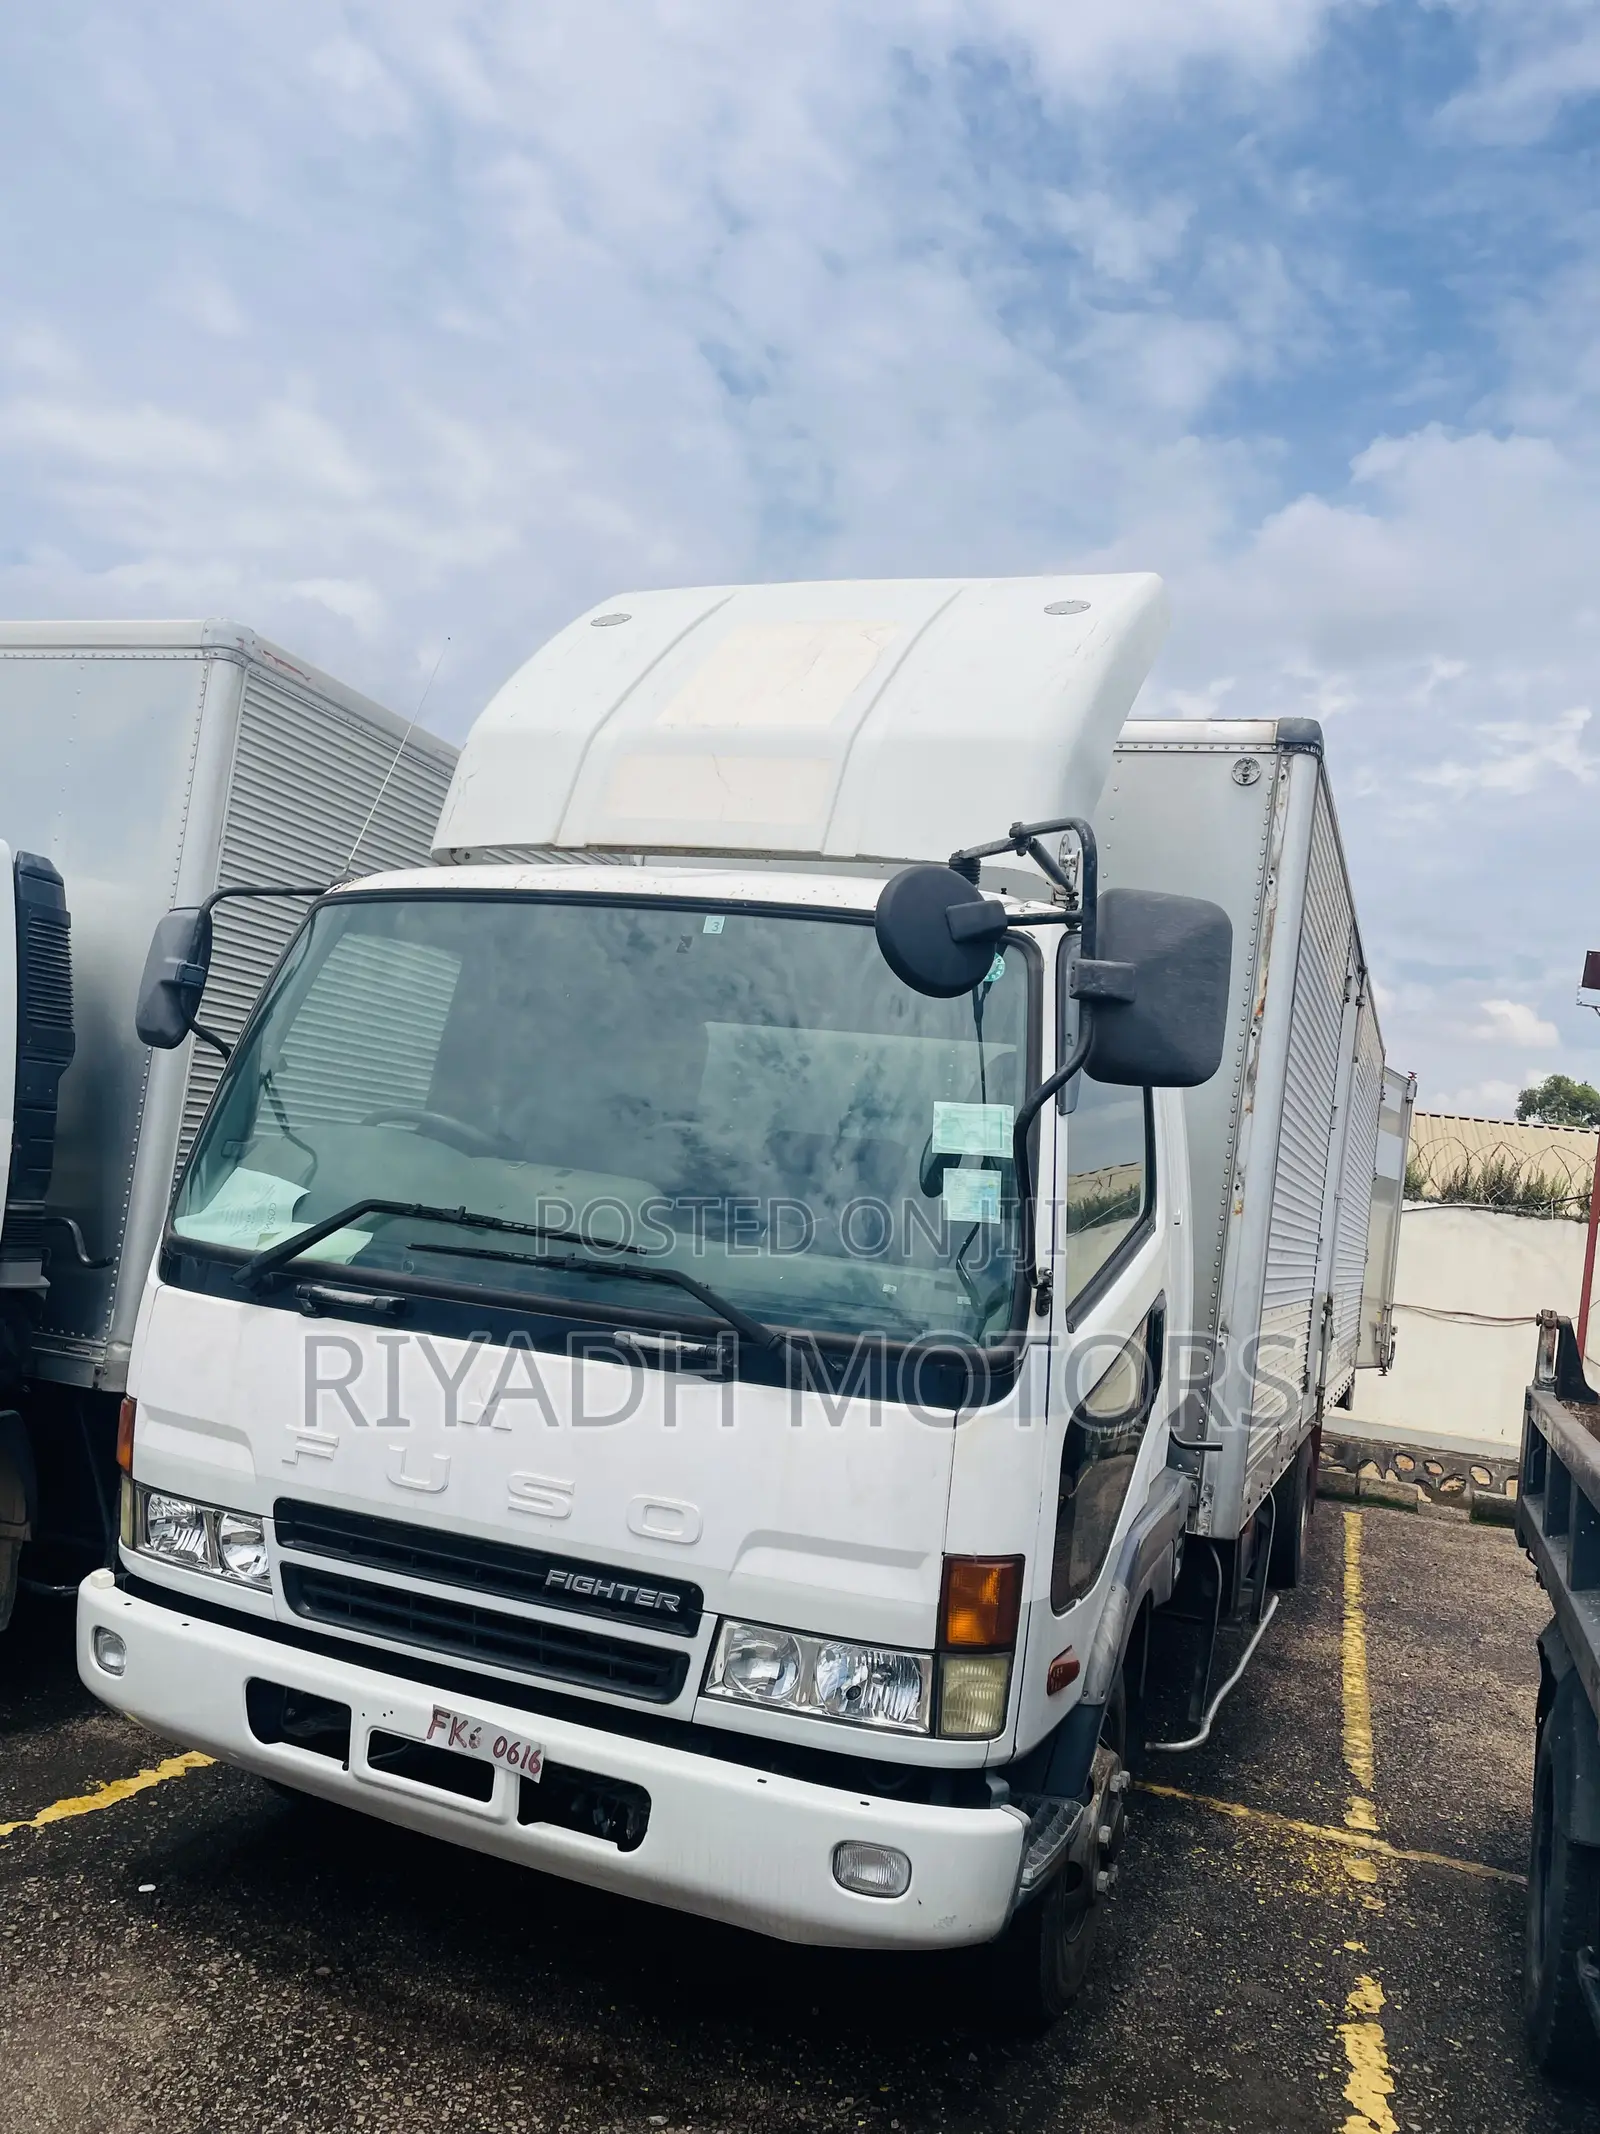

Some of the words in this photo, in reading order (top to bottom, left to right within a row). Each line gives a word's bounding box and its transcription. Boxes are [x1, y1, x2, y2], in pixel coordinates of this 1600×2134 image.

[281, 1424, 704, 1546] FUSO
[545, 1569, 681, 1612] FIGHTER
[492, 1735, 542, 1774] 0616
